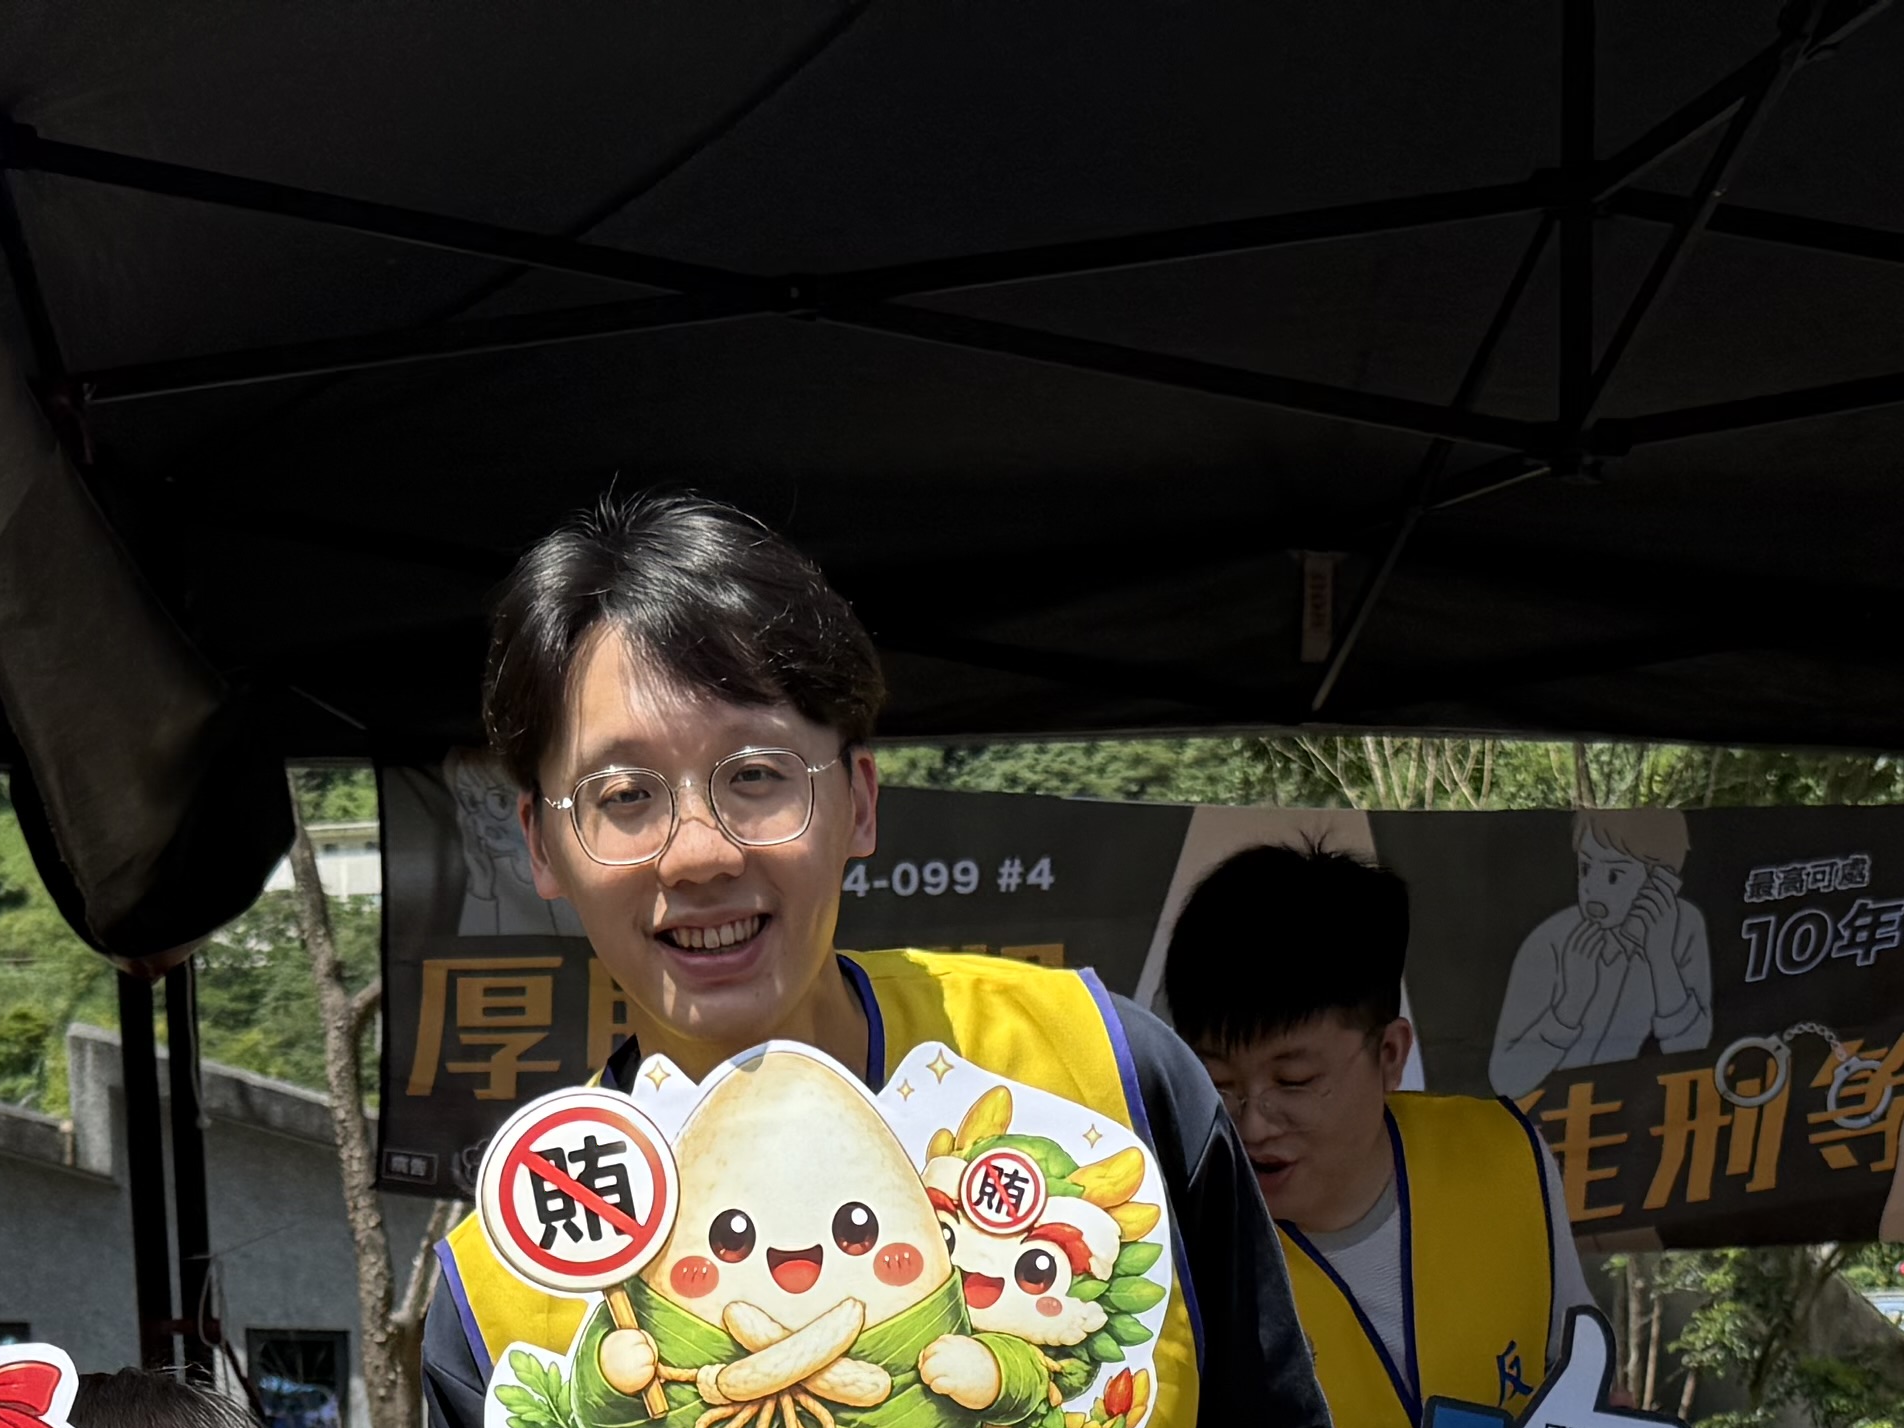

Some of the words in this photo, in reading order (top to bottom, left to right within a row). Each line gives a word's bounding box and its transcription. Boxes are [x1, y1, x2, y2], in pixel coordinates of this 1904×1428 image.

[997, 856, 1055, 893] #4
[1744, 855, 1872, 903] 最高可處
